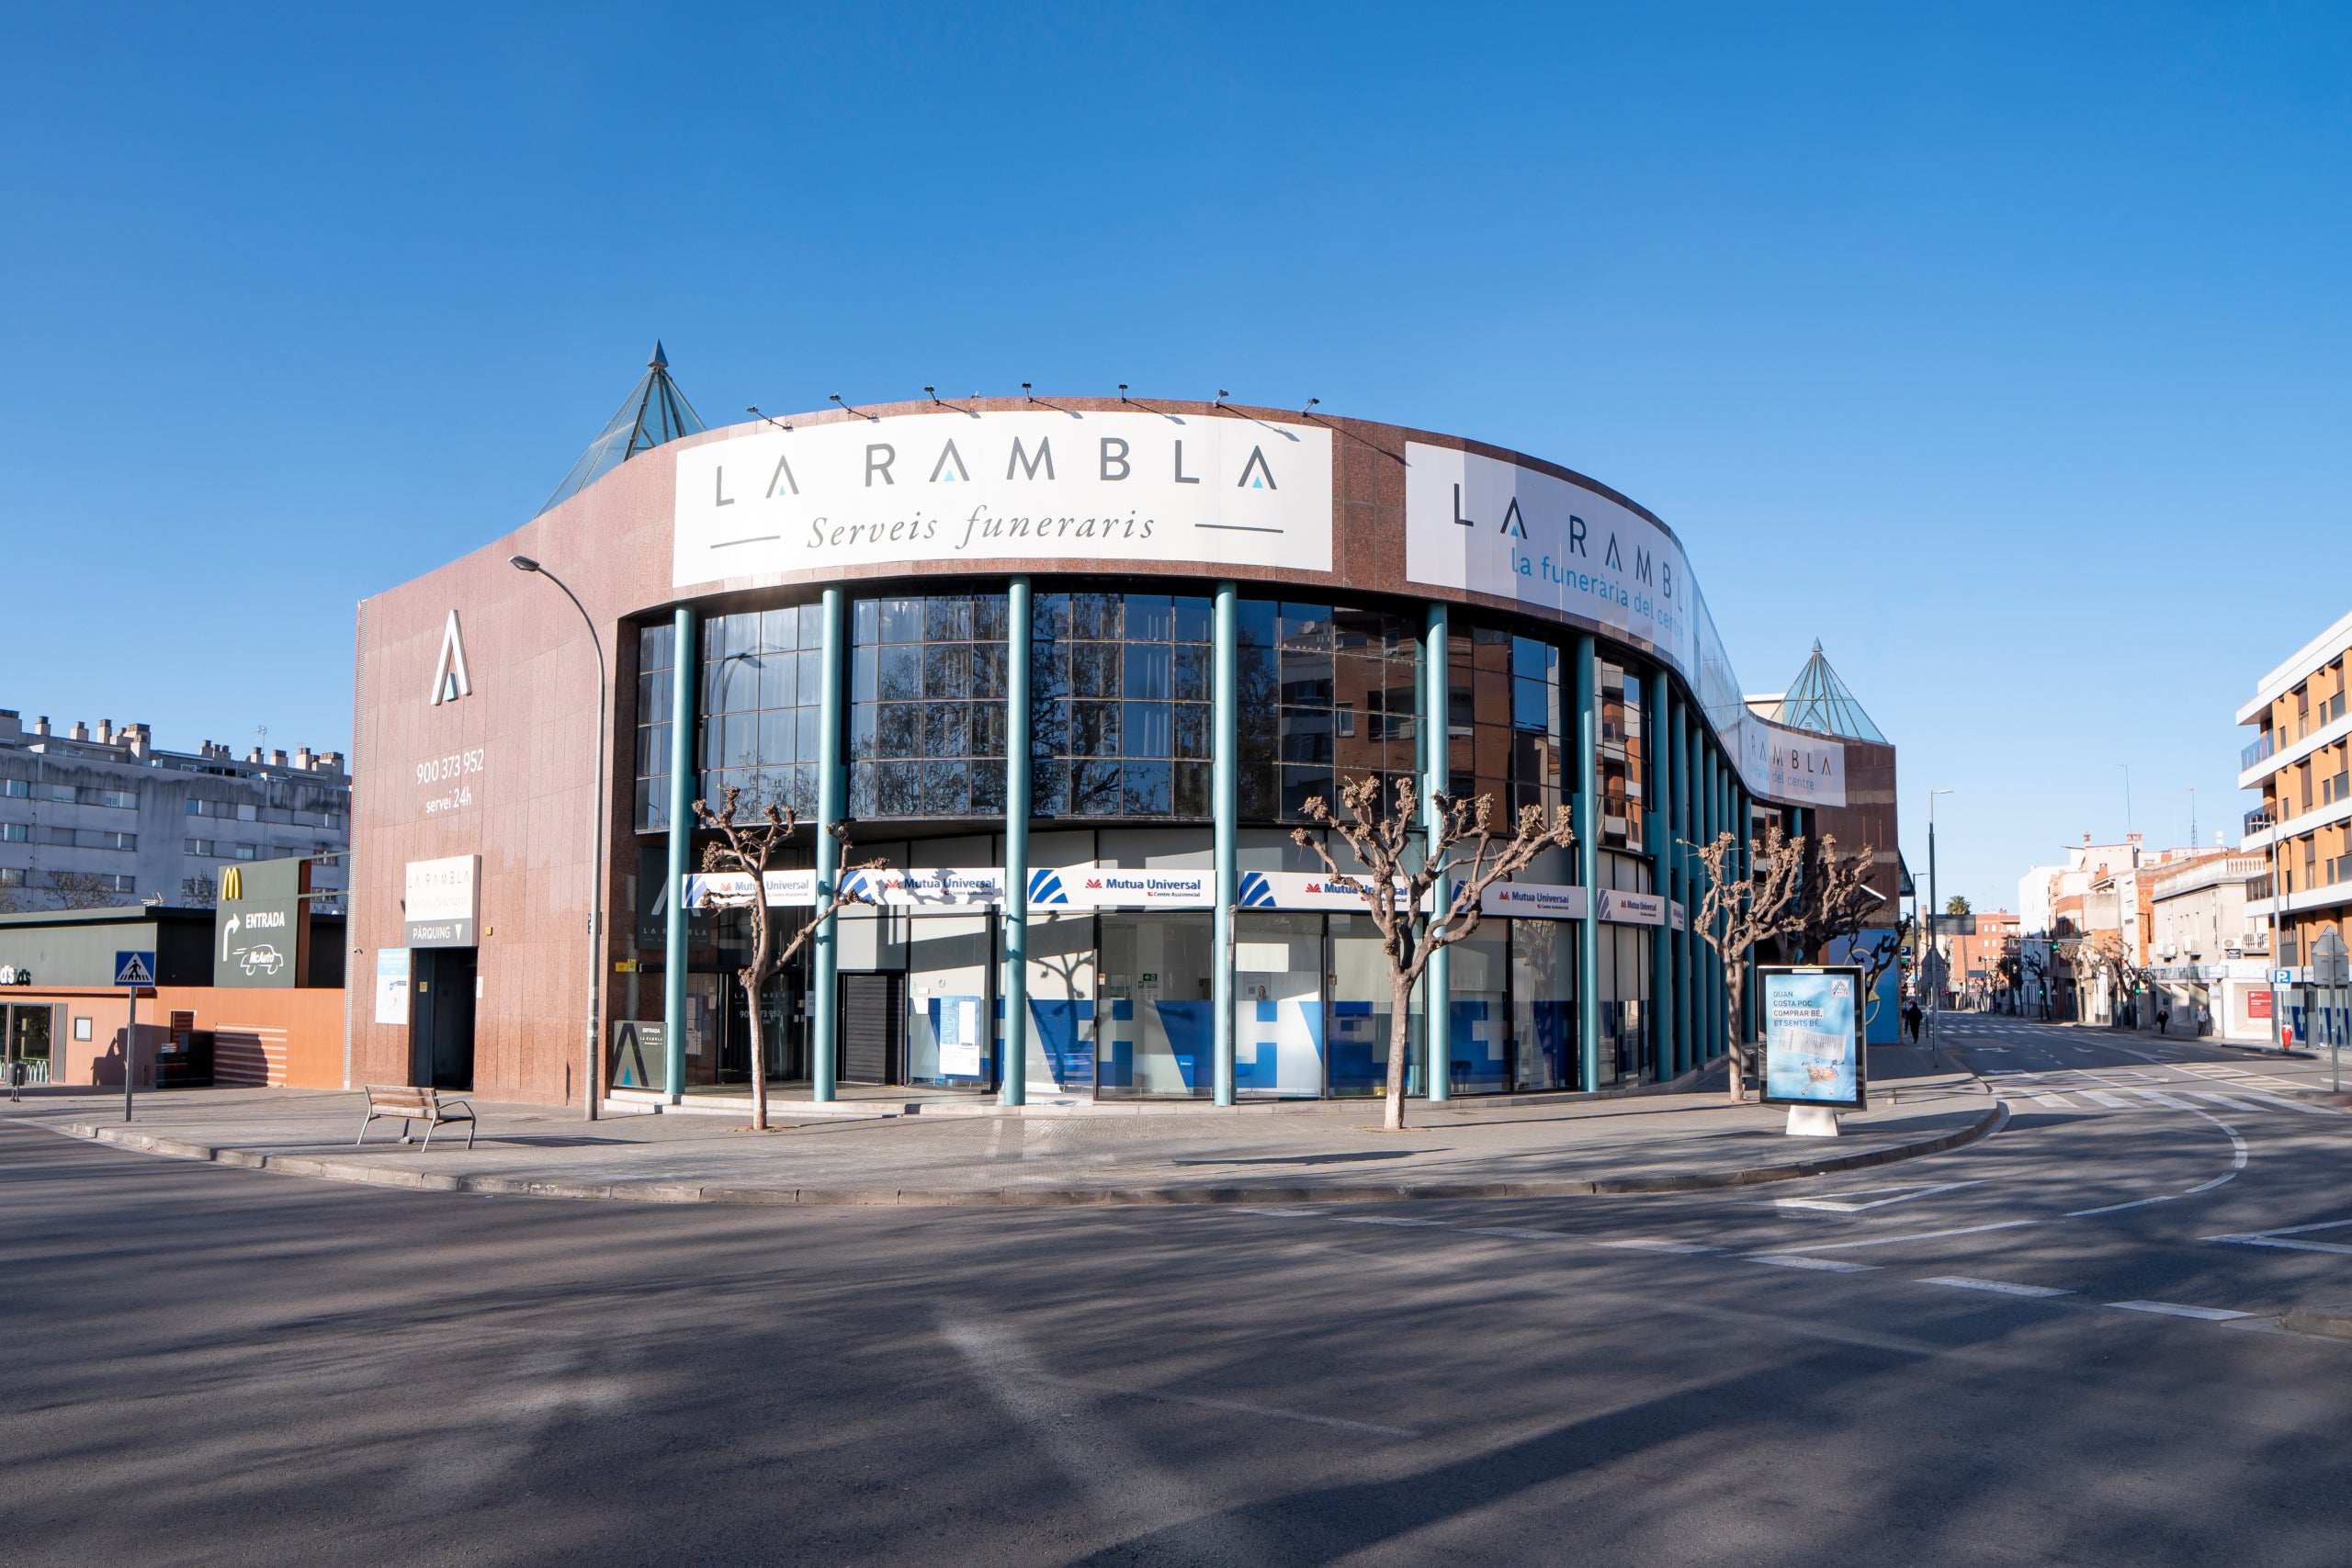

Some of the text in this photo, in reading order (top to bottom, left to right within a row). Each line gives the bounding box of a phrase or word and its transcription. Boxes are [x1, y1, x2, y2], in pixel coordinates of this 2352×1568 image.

[716, 435, 1277, 507] LA RAMBLA
[1453, 483, 1528, 540] LA
[807, 504, 1155, 549] Serveis funeraris
[1510, 547, 1532, 577] la
[1541, 556, 1629, 608] funerària
[1634, 591, 1655, 620] del
[416, 748, 484, 785] 900 373 952
[1771, 770, 1785, 785] del
[1787, 775, 1815, 791] centre
[425, 785, 472, 814] servei 24h
[735, 879, 808, 891] Mutu Universal
[904, 877, 995, 889] Mutua Universal
[1105, 878, 1201, 890] Mutua Universal
[1324, 883, 1359, 894] Mutua
[1511, 891, 1568, 904] Mutua Universal
[245, 911, 286, 929] ENTRADA
[413, 924, 451, 941] PÀRQUING
[249, 952, 275, 964] McAuto
